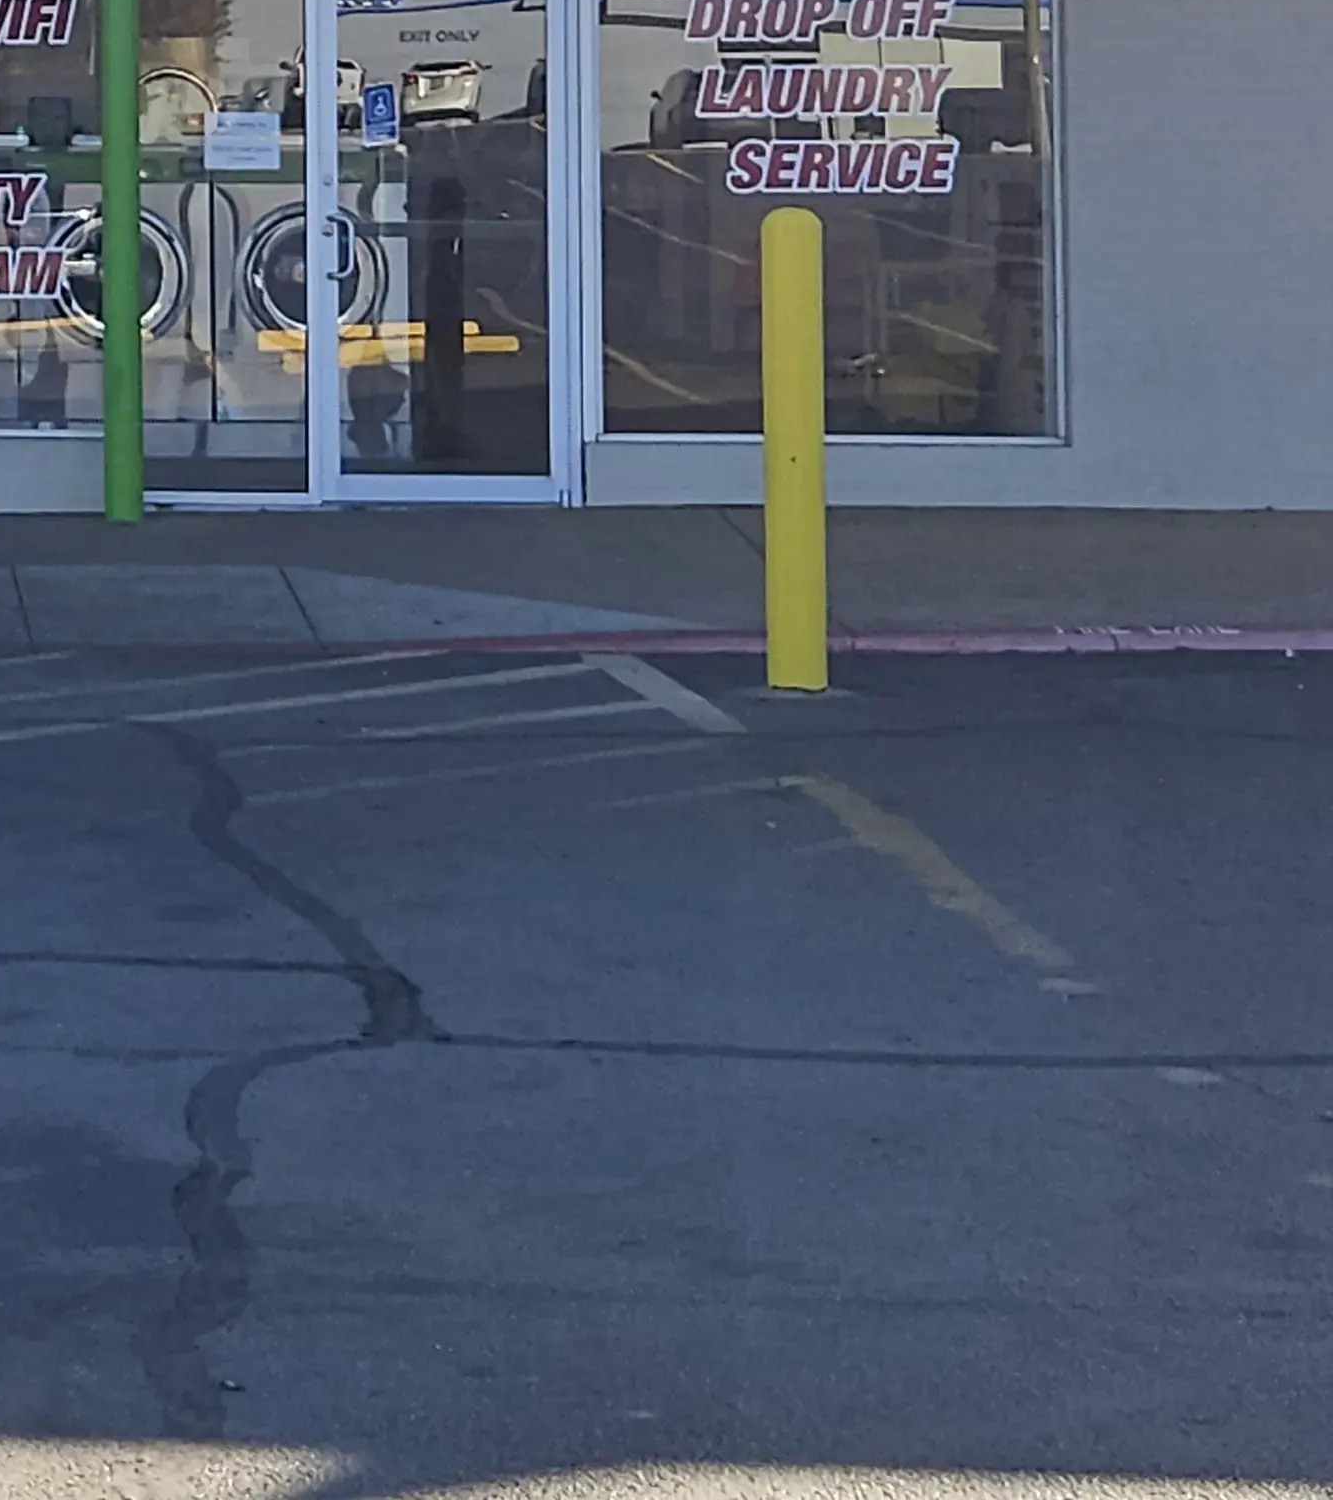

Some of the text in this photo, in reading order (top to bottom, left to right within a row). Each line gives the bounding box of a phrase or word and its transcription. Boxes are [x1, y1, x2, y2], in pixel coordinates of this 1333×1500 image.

[399, 30, 480, 43] EXIT ONLY
[695, 64, 953, 118] LAUNDRY
[727, 138, 960, 194] SERVICE
